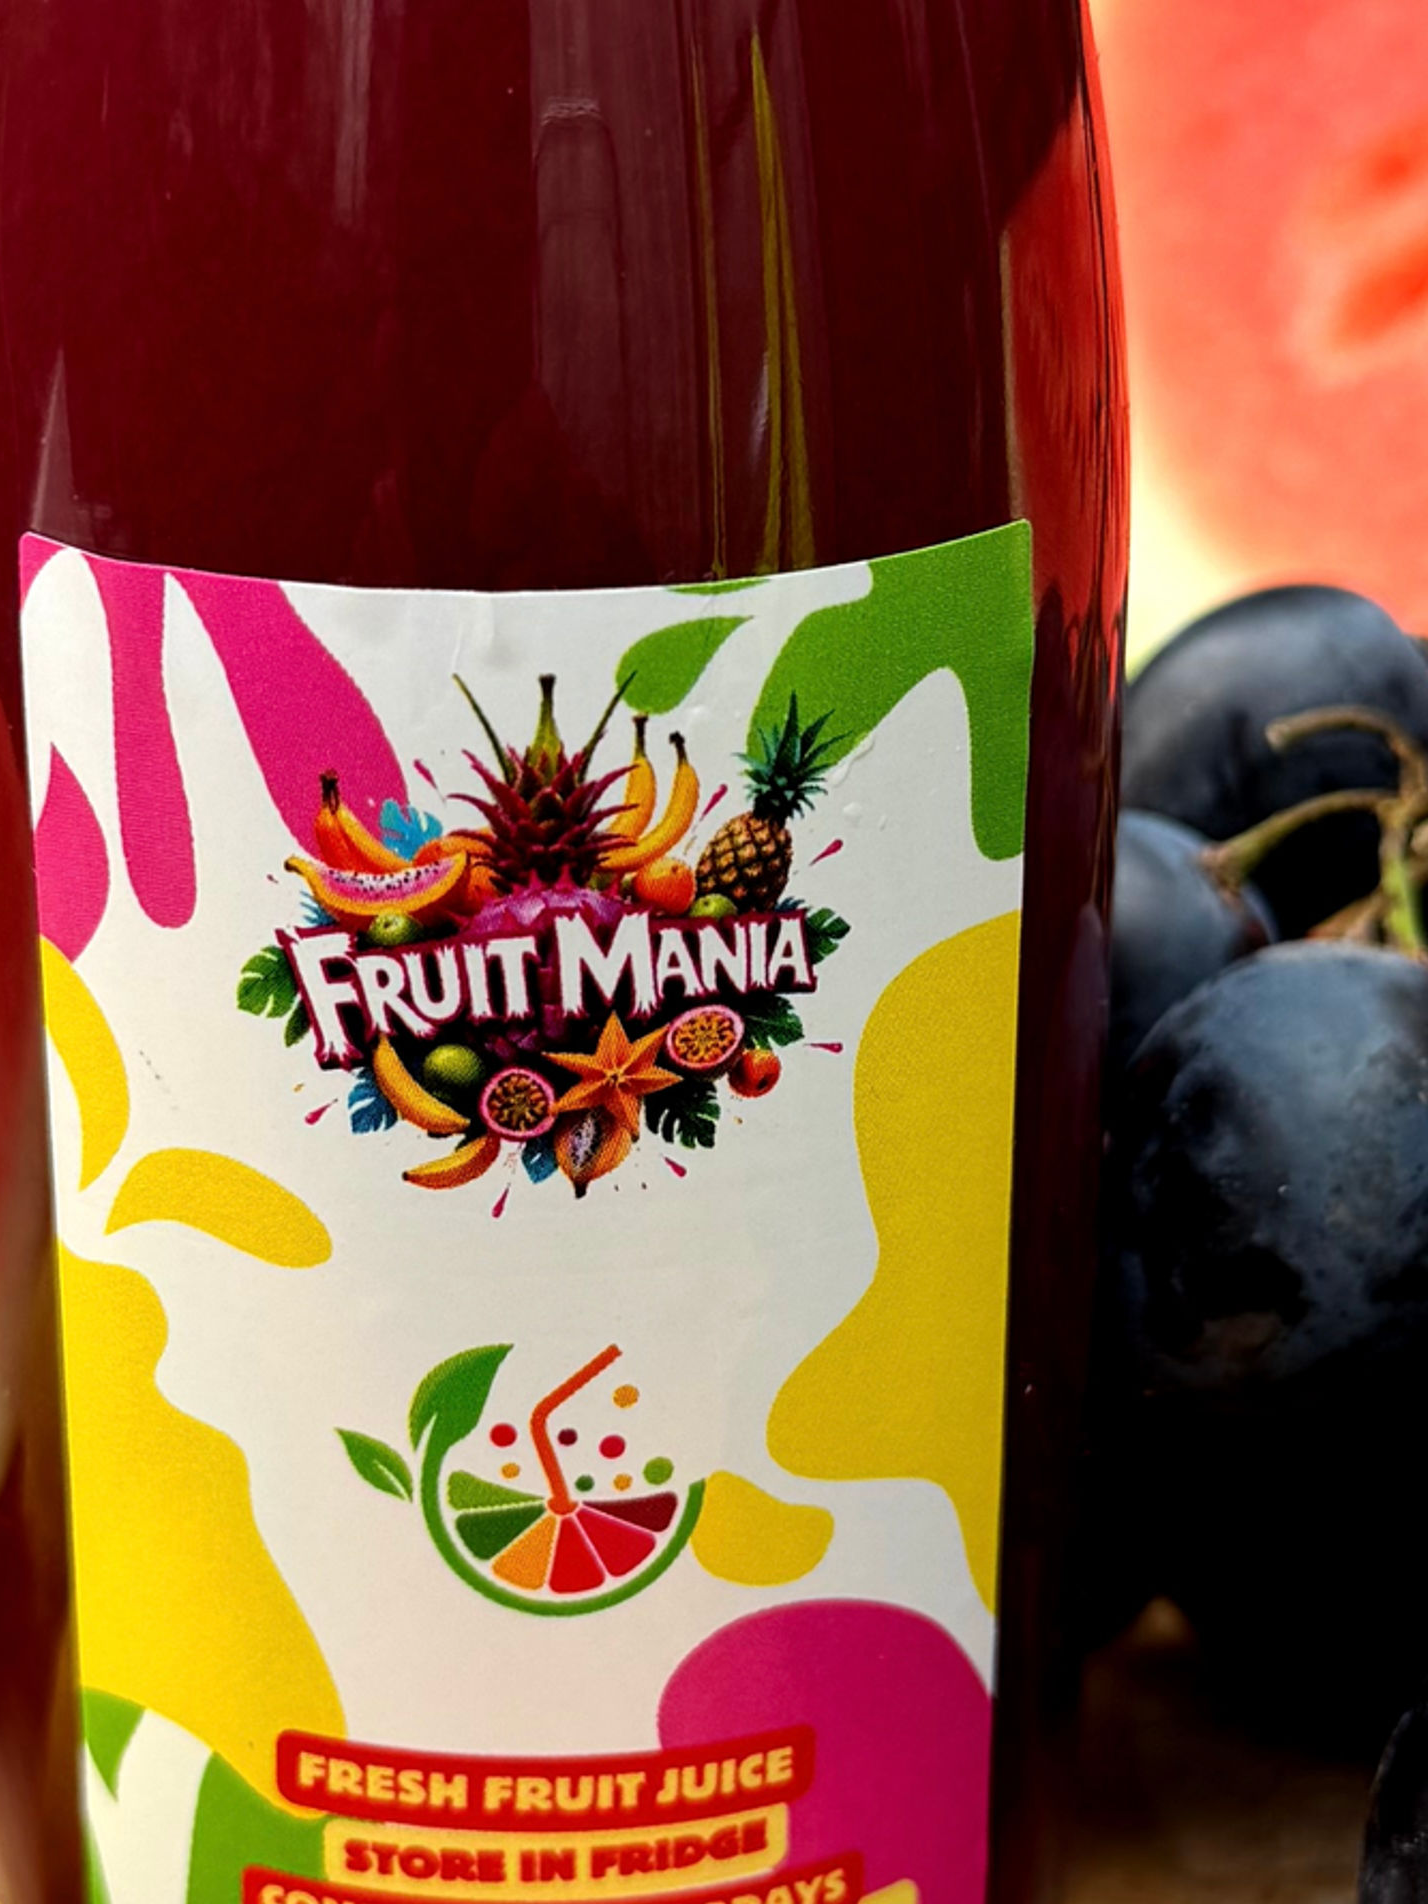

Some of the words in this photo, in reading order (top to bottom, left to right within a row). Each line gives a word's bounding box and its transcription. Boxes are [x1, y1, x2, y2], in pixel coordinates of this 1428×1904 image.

[284, 930, 536, 1066] FRUIT
[555, 912, 815, 1019] MANIA
[298, 1752, 468, 1808] FRESH
[483, 1772, 646, 1811] FRUIT
[657, 1746, 794, 1803] JUICE
[344, 1840, 506, 1884] STORE
[520, 1845, 577, 1882] IN
[591, 1818, 768, 1879] FRIDGE
